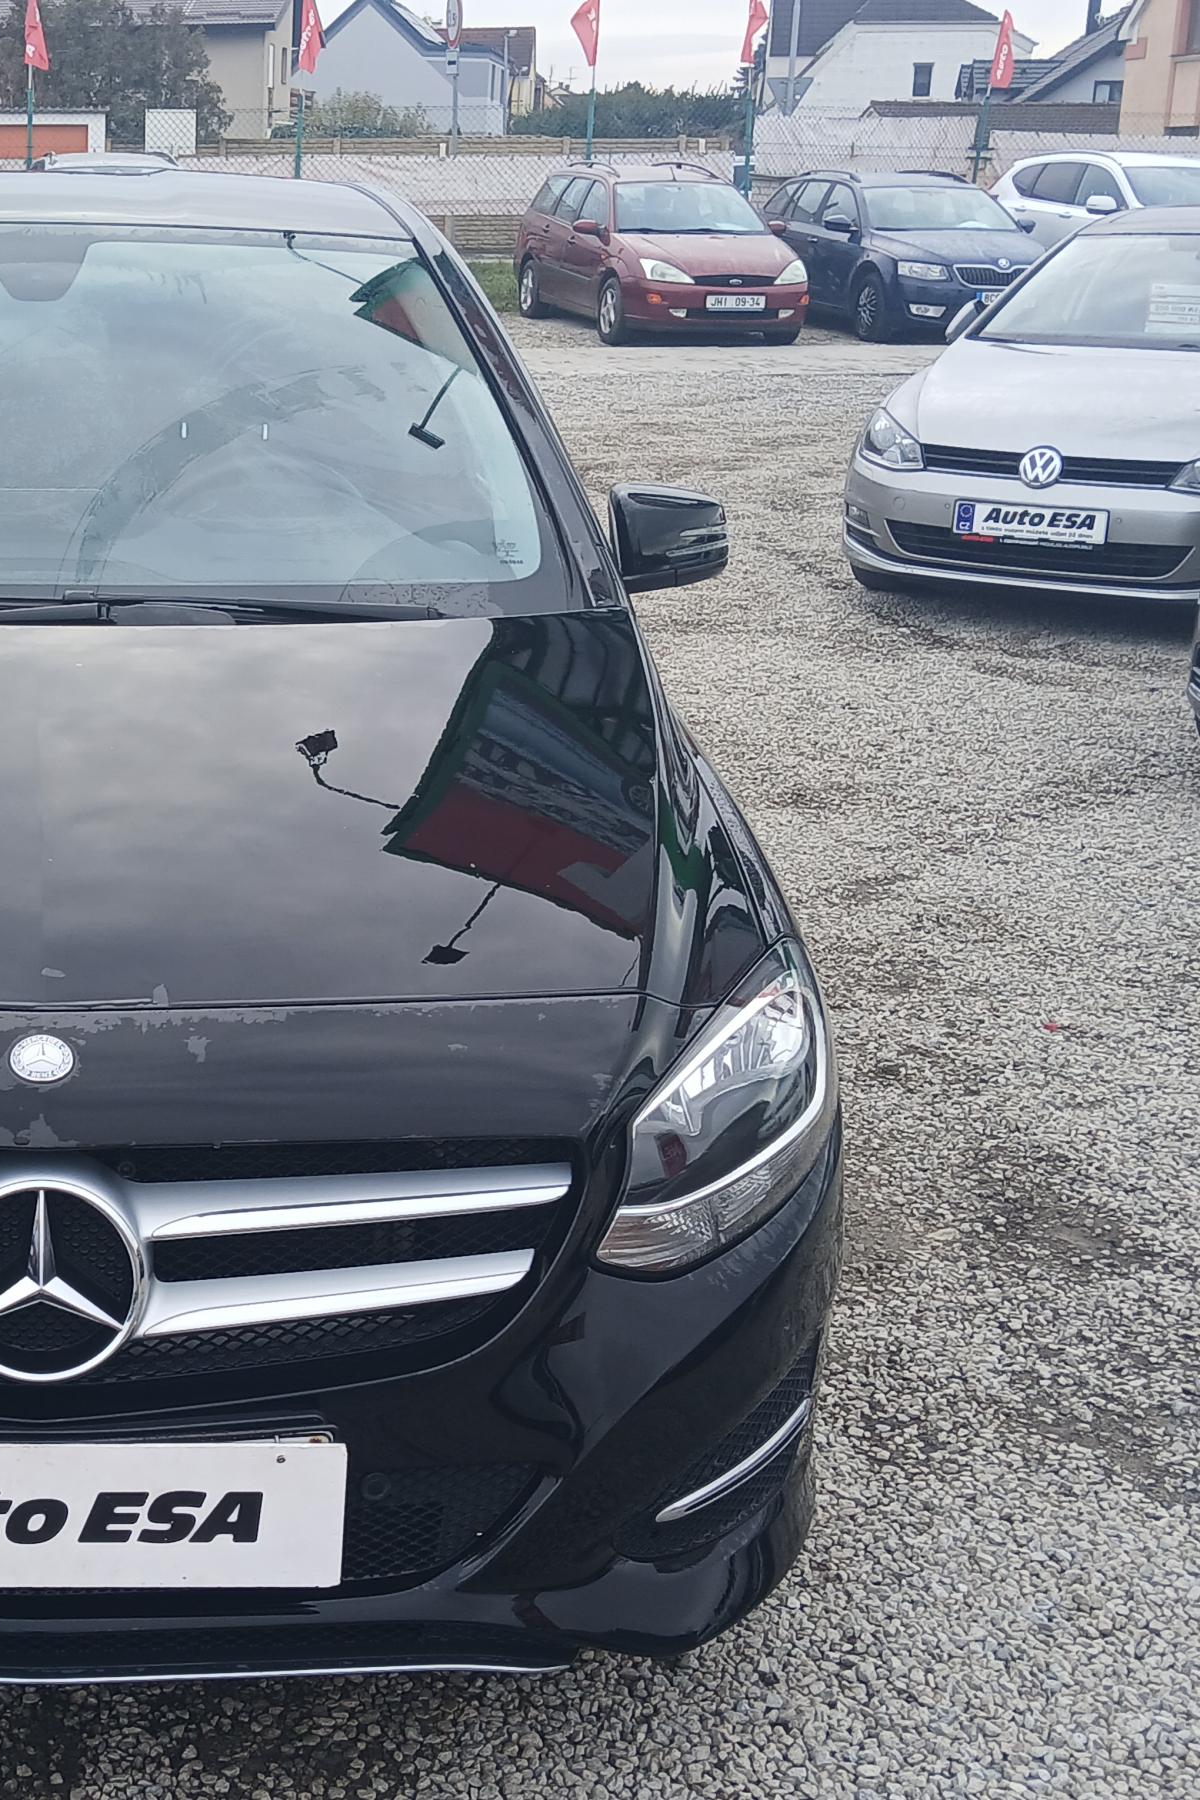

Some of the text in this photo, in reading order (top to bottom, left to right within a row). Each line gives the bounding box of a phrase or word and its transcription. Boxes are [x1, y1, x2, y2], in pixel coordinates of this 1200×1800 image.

[711, 296, 760, 307] JHI 09-34
[959, 521, 970, 530] CZ
[983, 507, 1097, 531] Auto ESA
[77, 1490, 264, 1544] ESA
